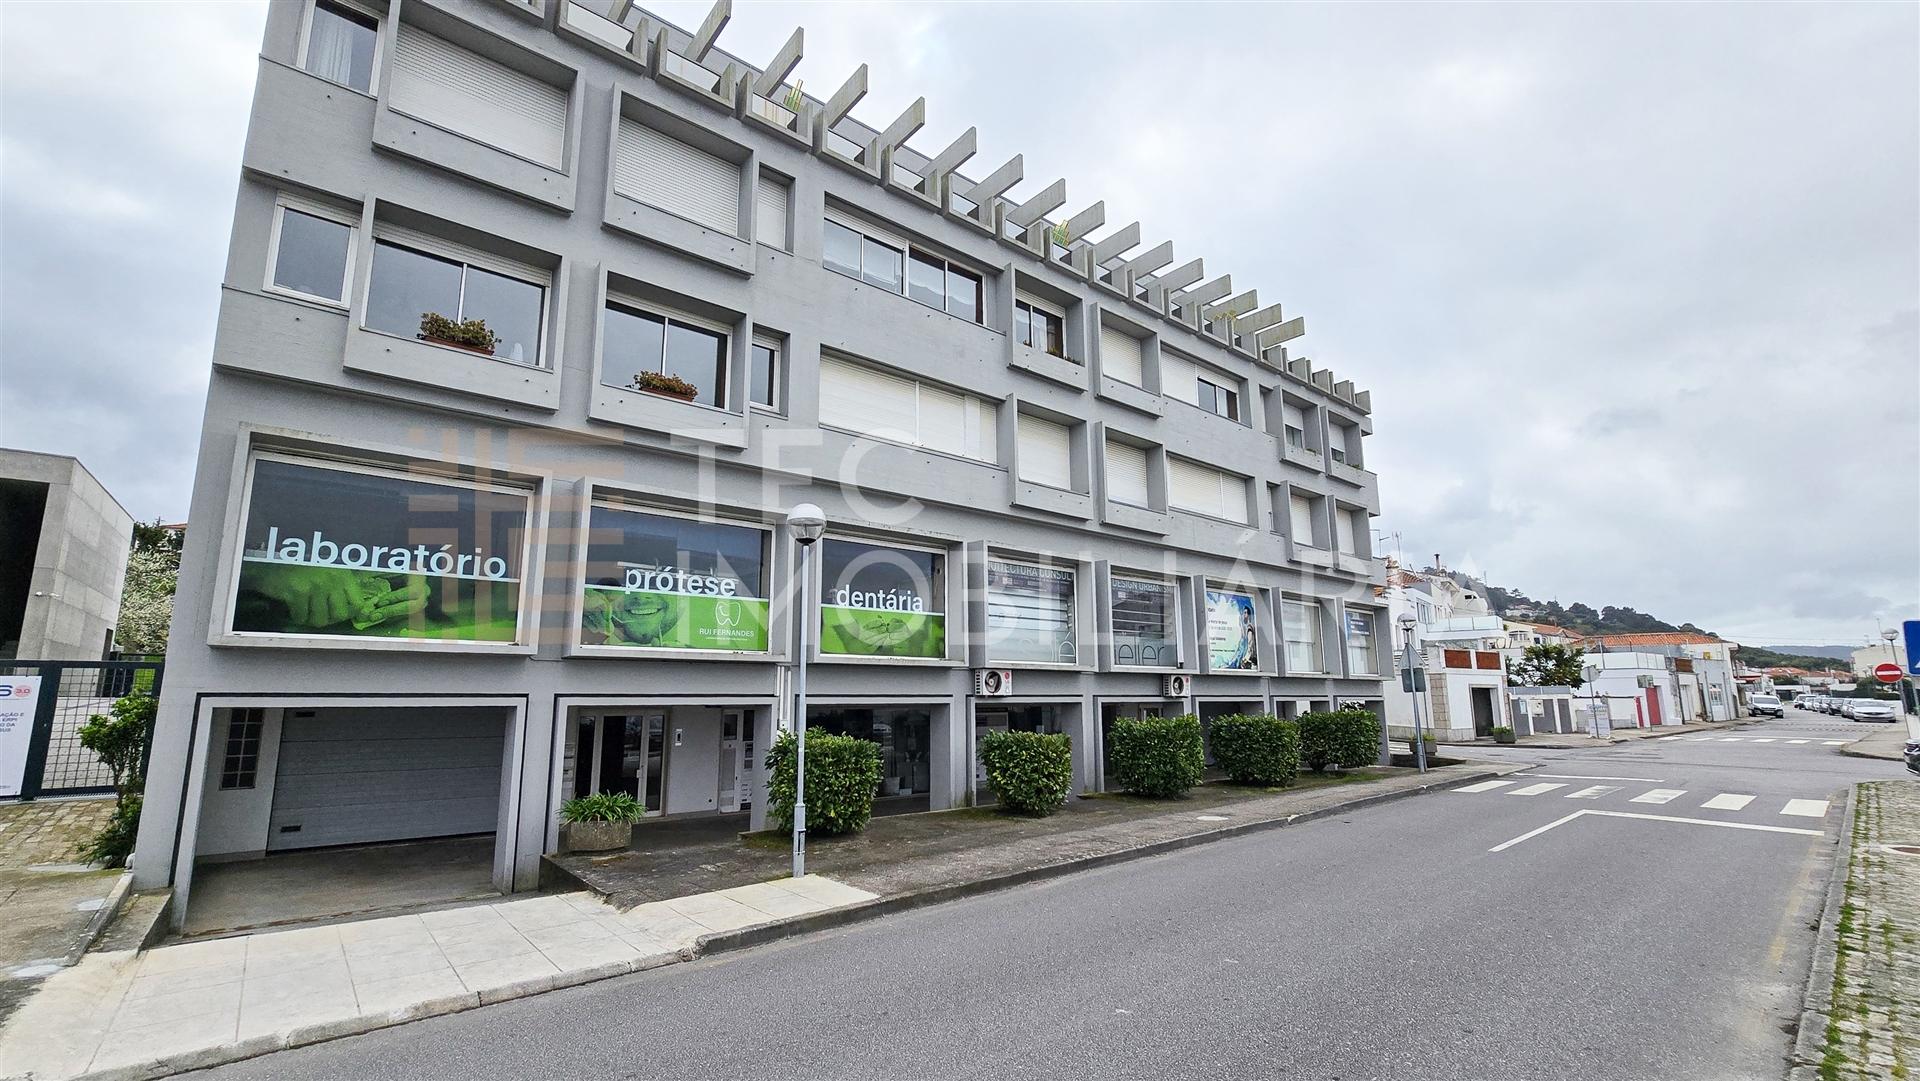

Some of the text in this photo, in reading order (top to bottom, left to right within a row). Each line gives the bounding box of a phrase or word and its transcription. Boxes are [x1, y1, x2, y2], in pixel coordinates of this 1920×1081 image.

[266, 526, 507, 579] laboratório
[625, 566, 736, 597] prótese
[836, 574, 923, 612] dentária
[699, 627, 755, 637] RUI FERNANDES
